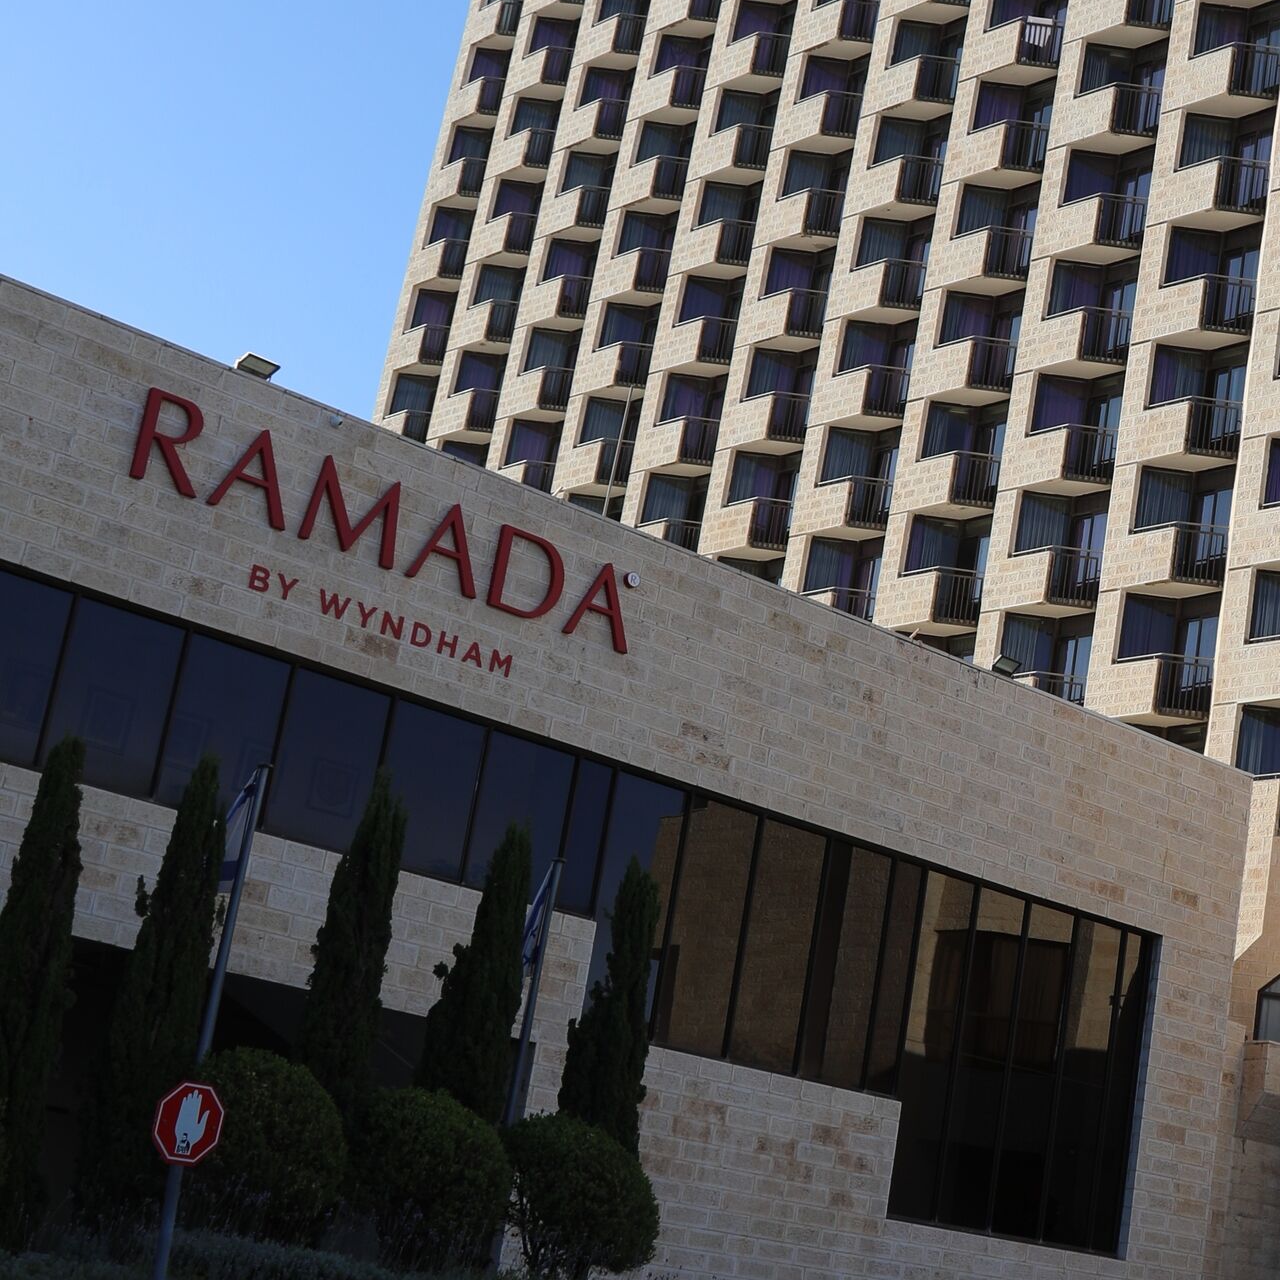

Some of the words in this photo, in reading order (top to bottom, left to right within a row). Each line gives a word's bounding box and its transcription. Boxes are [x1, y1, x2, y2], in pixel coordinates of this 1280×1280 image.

[129, 386, 628, 654] RAMADA
[248, 564, 299, 600] BY
[319, 588, 513, 678] WYNDHAM
